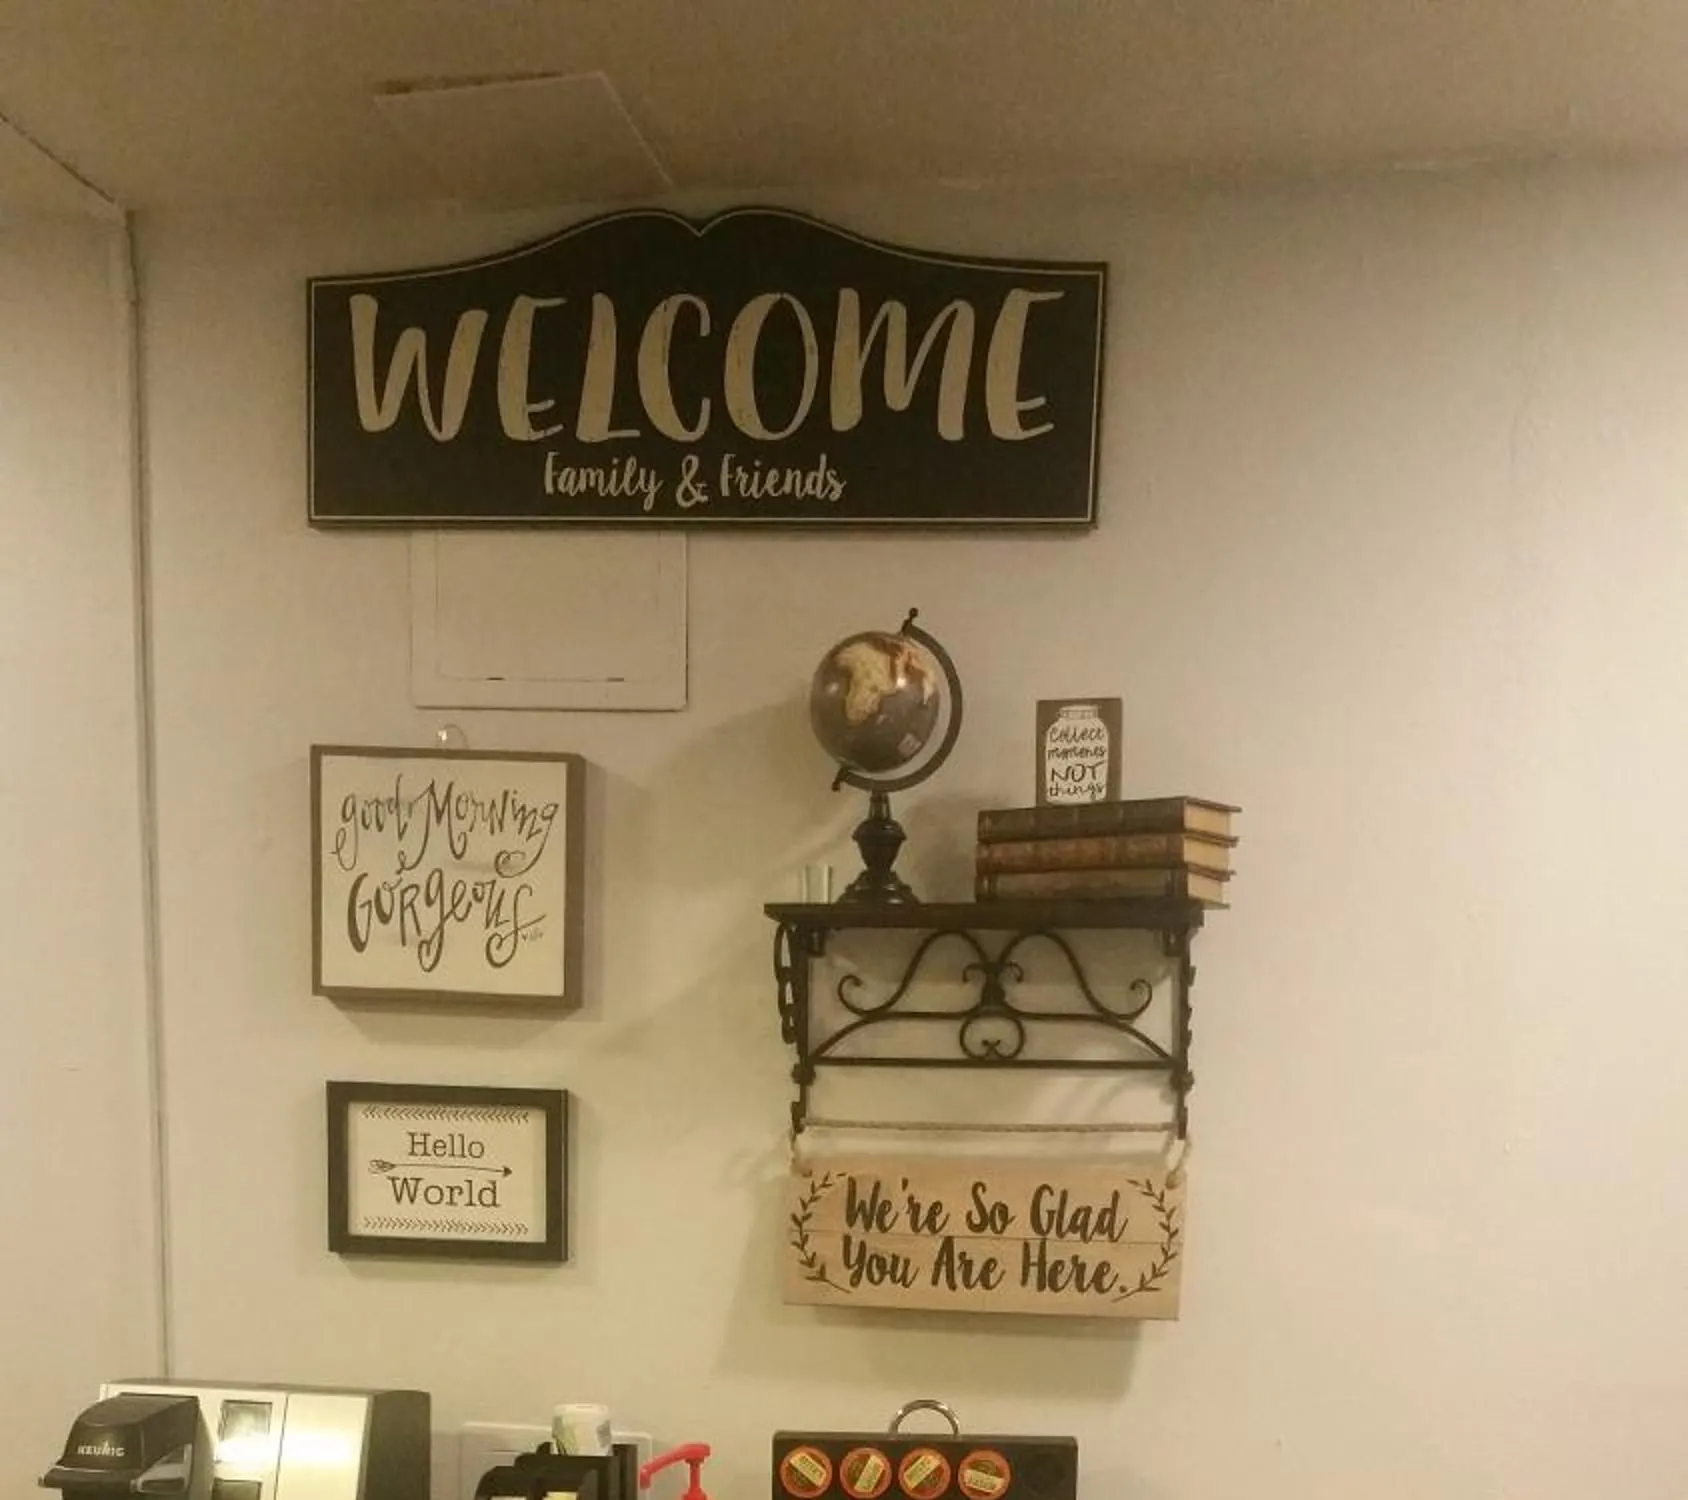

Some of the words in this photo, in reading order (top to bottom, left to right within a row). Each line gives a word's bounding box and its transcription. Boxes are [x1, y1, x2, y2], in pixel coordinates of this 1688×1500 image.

[349, 287, 1066, 443] WELCOME
[543, 450, 666, 511] Family
[676, 454, 709, 508] &
[720, 452, 848, 502] Friends
[1050, 760, 1106, 782] NOT
[406, 1131, 486, 1158] Hello
[387, 1175, 502, 1208] World
[844, 1175, 950, 1234] We're
[965, 1181, 1014, 1234] So
[1029, 1183, 1128, 1243] Glad
[842, 1233, 919, 1289] You
[930, 1235, 1004, 1292] Are
[1020, 1237, 1128, 1294] Here.
